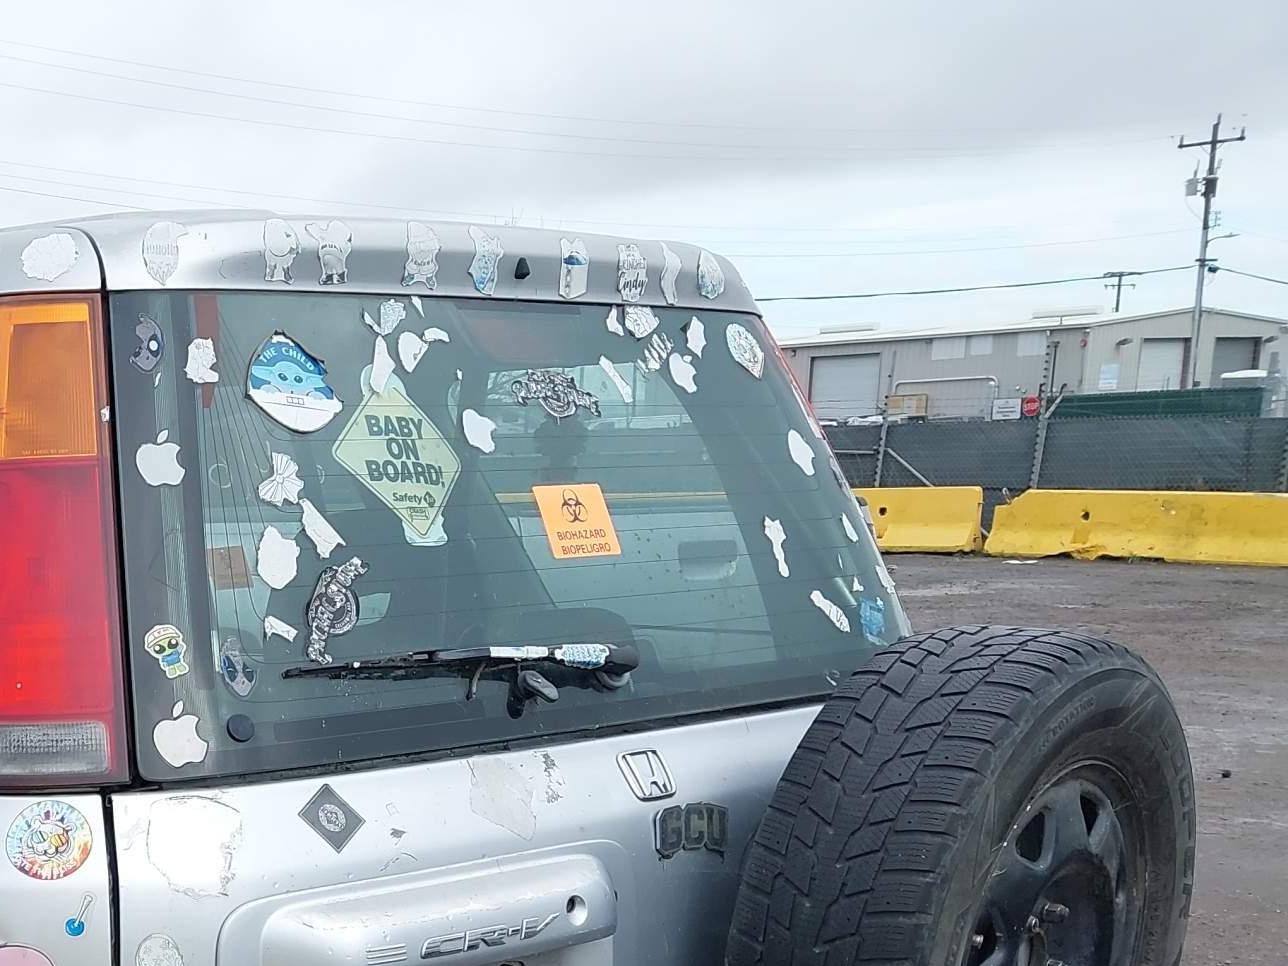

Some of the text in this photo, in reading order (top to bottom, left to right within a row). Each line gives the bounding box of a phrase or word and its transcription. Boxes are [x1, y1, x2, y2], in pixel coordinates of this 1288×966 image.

[259, 346, 315, 371] THE CHILD
[365, 415, 423, 439] BABY
[386, 438, 420, 460] ON
[365, 459, 446, 488] BOARD!
[392, 492, 422, 504] Safety
[556, 528, 607, 541] BIOHAZARD
[561, 542, 612, 555] BIOPELIGRO
[420, 911, 561, 959] CR-V
